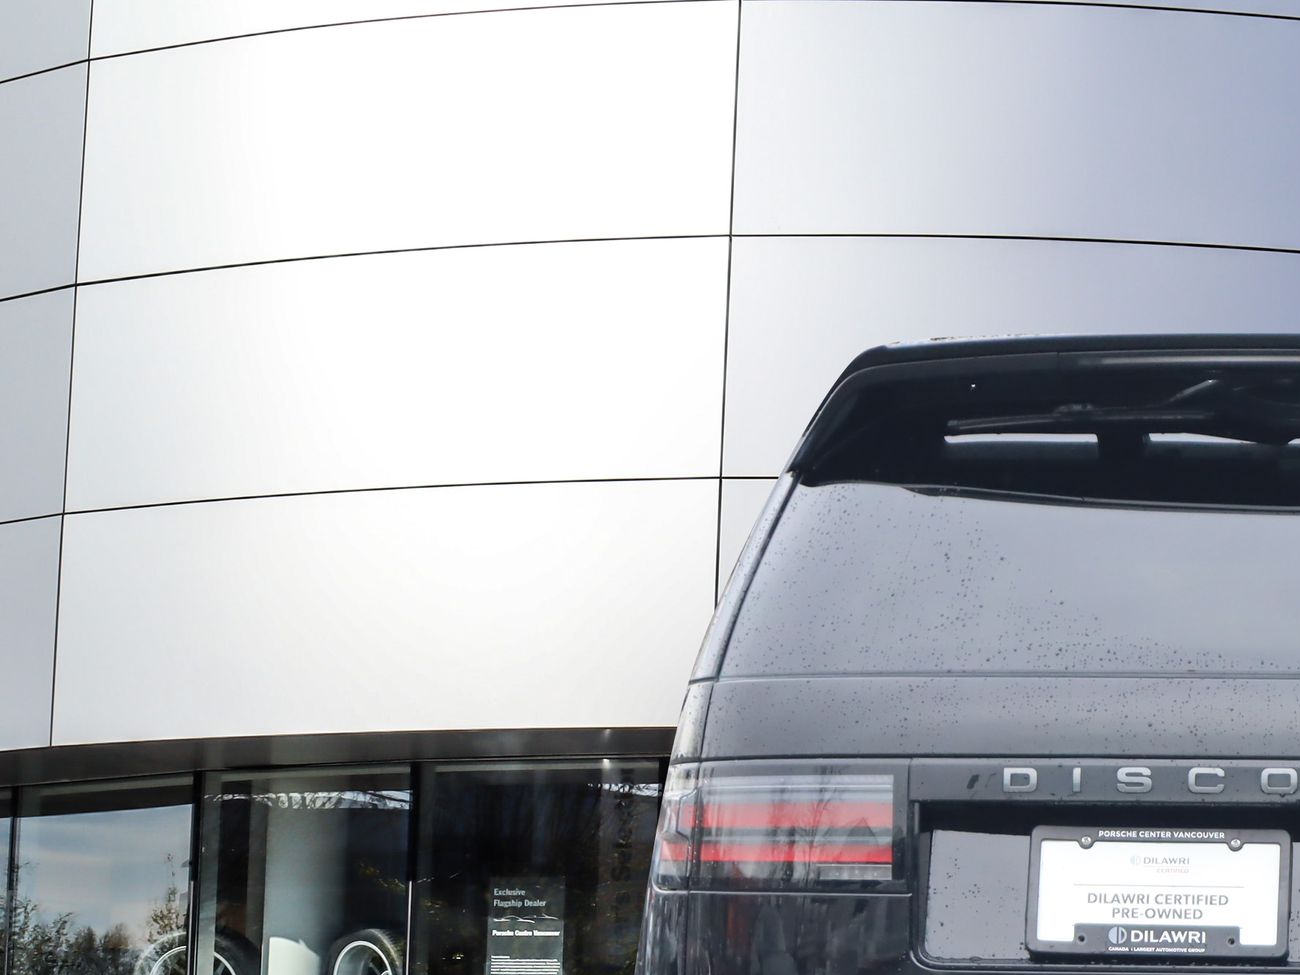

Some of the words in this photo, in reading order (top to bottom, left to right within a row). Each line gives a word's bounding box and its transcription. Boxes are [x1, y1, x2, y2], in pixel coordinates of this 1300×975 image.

[1098, 830, 1137, 838] PORSCHE
[1173, 831, 1225, 839] VANCOUVER
[1143, 856, 1190, 865] DILAWRI
[493, 888, 526, 896] Exclusive
[493, 899, 523, 908] Flagship
[524, 899, 547, 907] Dealer
[1087, 892, 1150, 905] DILAWRI
[1154, 893, 1229, 906] CERTIFIED
[1112, 907, 1203, 920] PRE-OWNED
[1130, 929, 1206, 944] DILAWRI
